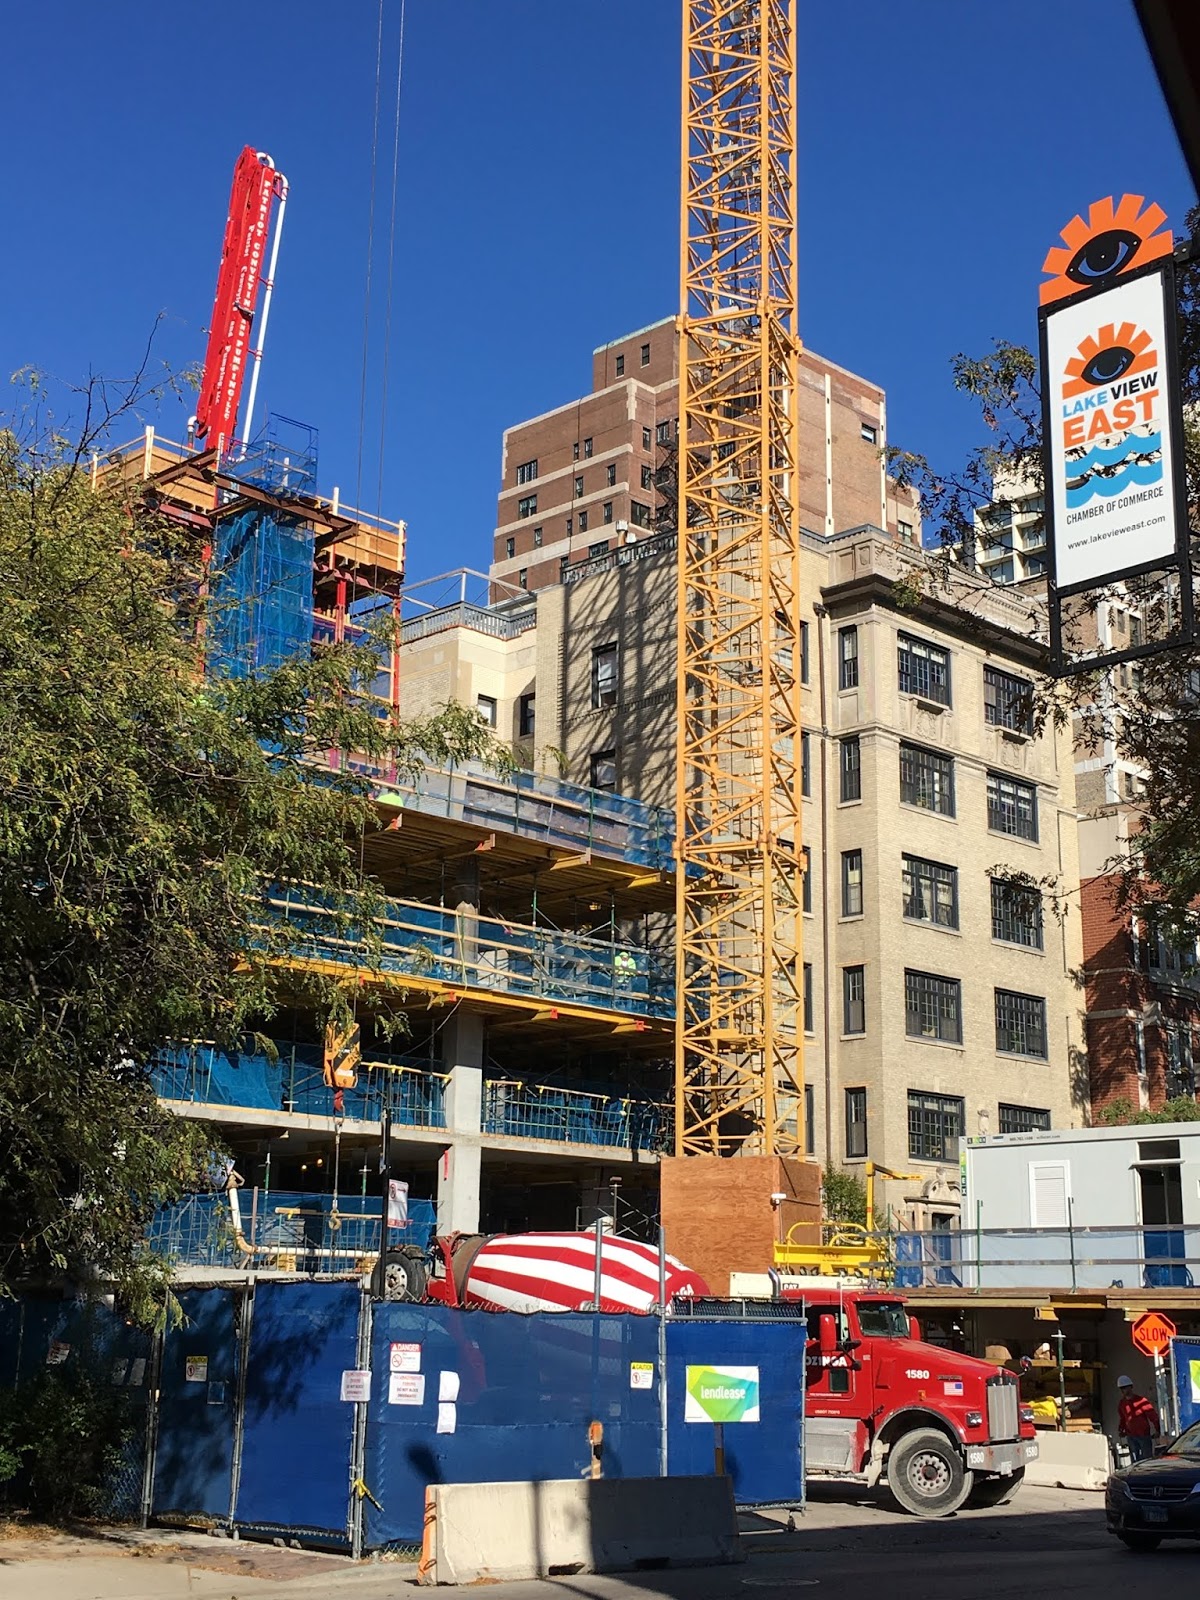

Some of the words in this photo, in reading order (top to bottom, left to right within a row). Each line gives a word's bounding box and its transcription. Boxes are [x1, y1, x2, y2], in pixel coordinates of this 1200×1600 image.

[256, 180, 272, 237] PATRIOT
[243, 242, 261, 312] CONVEYIN
[1063, 391, 1108, 418] LAKE
[1110, 371, 1158, 400] VIEW
[1063, 389, 1159, 448] EAST
[1066, 504, 1104, 525] CHAMBER
[1106, 500, 1117, 512] OF
[1118, 486, 1164, 509] COMMERCE
[1067, 515, 1166, 550] www.lakevieweast.com
[1139, 1327, 1168, 1341] SLOW
[905, 1369, 930, 1379] 1580
[701, 1385, 746, 1399] lendlease
[970, 1452, 985, 1464] 1580
[1025, 1446, 1038, 1457] 1580
